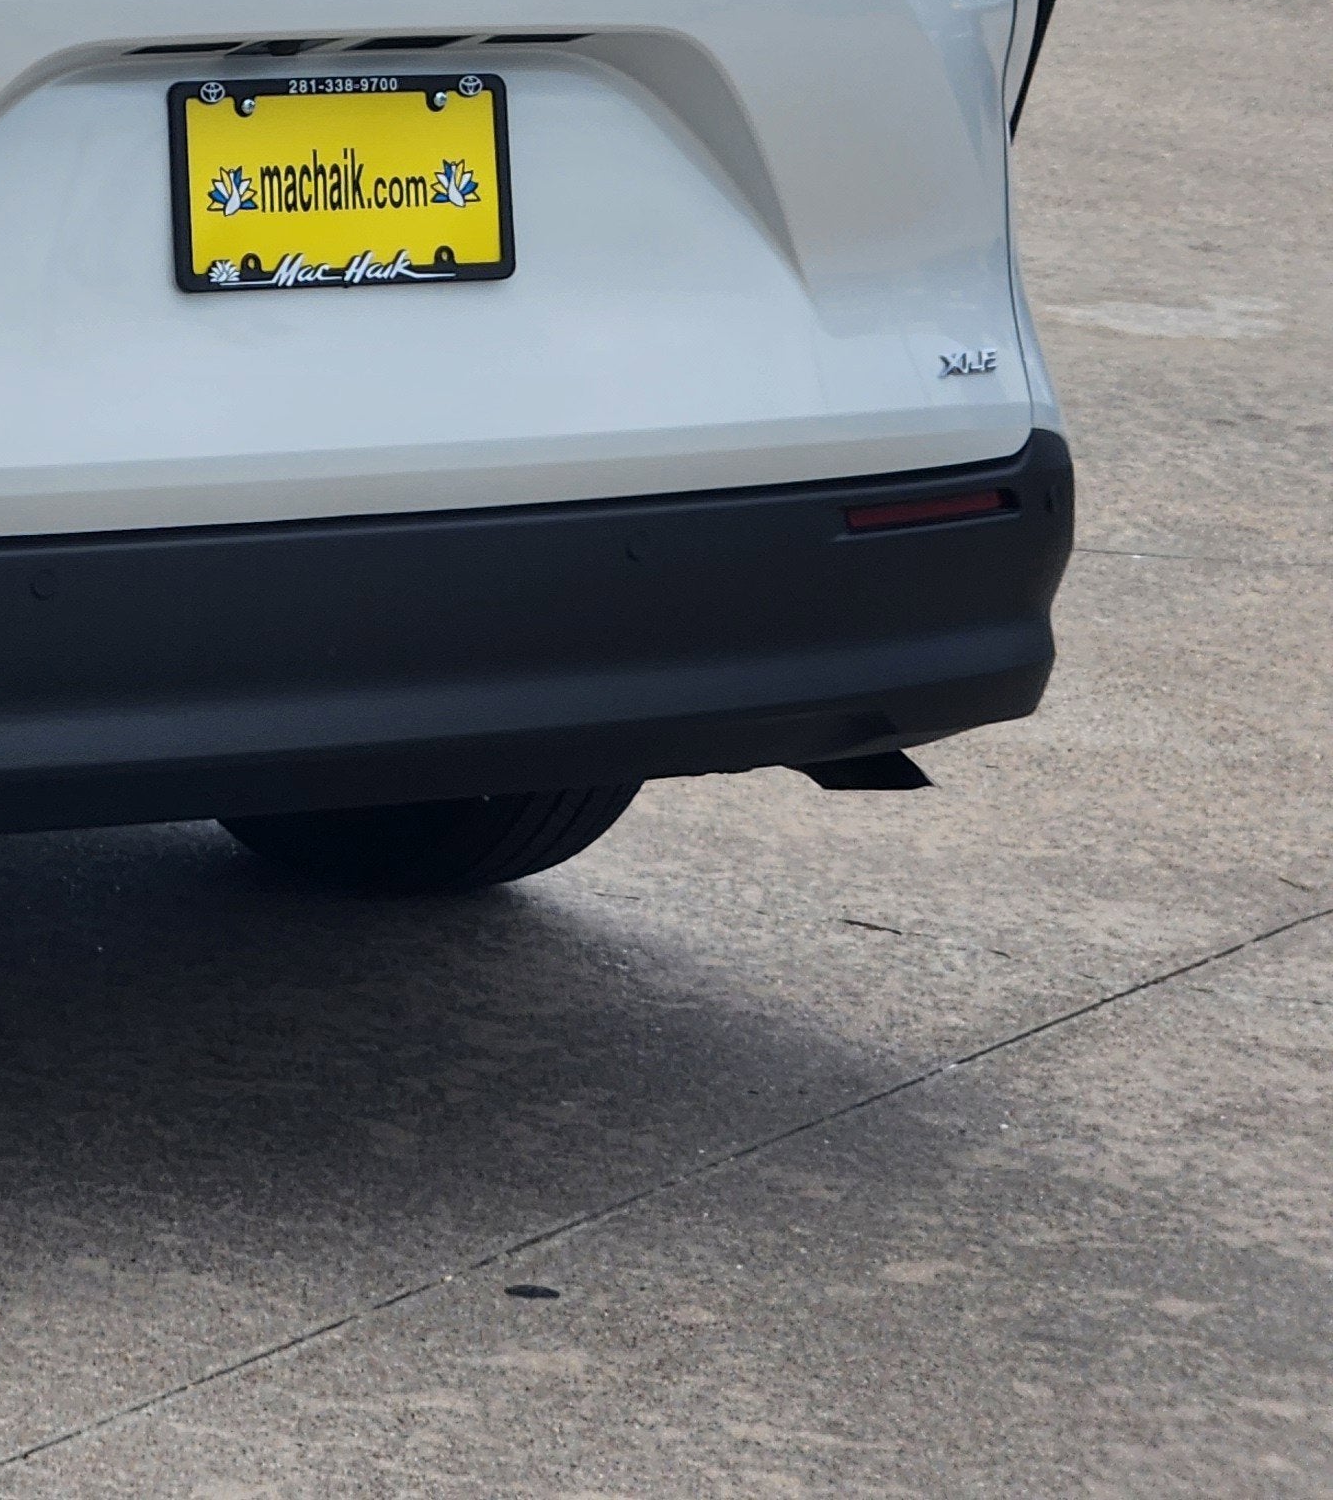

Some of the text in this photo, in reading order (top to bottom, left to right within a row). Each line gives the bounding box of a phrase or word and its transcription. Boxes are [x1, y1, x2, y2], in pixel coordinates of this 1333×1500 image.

[288, 77, 398, 95] 281-338-9700
[259, 147, 429, 213] machaik.com
[269, 249, 421, 287] Mac Haik
[936, 348, 999, 379] XLE
